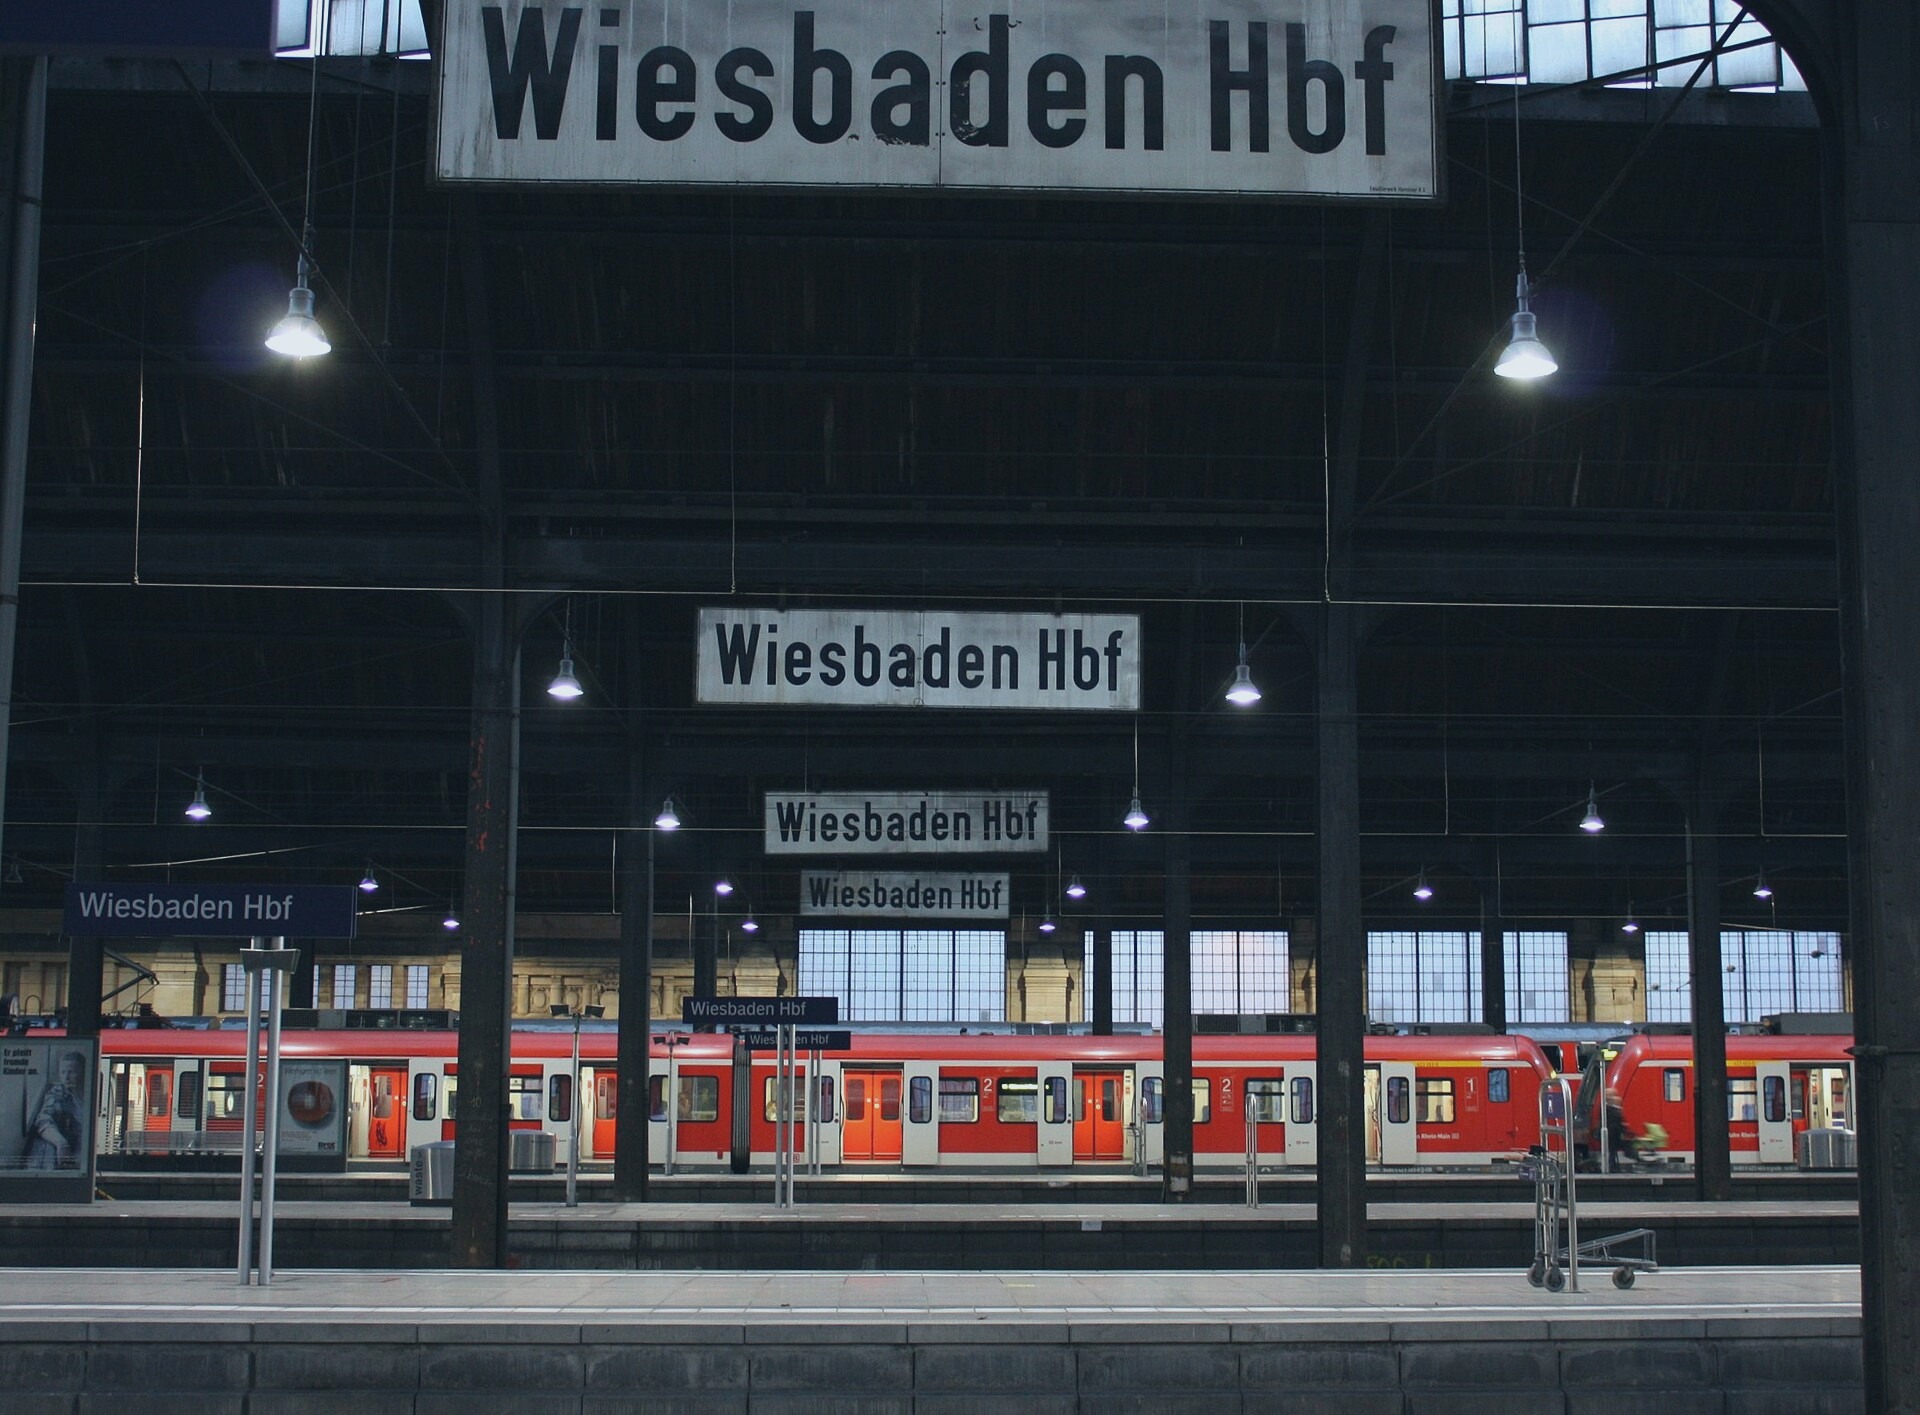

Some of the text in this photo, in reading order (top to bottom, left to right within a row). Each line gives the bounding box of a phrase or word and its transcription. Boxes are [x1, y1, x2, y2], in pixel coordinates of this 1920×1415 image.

[482, 7, 1398, 155] Wiesbaden Hbf
[716, 623, 1124, 691] Wiesbaden Hbf
[776, 800, 1039, 842] Wiesbaden Hbf
[808, 877, 1002, 910] Wiesbaden Hbf
[79, 892, 293, 920] Wiesbaden Hbf
[690, 1001, 807, 1016] Wiesbaden Hbf
[750, 1034, 830, 1045] Wiesaen Hbf
[257, 1073, 264, 1088] 2
[983, 1078, 993, 1092] 2
[1222, 1078, 1231, 1092] 2
[1467, 1078, 1475, 1092] 1
[414, 1161, 424, 1196] waste
